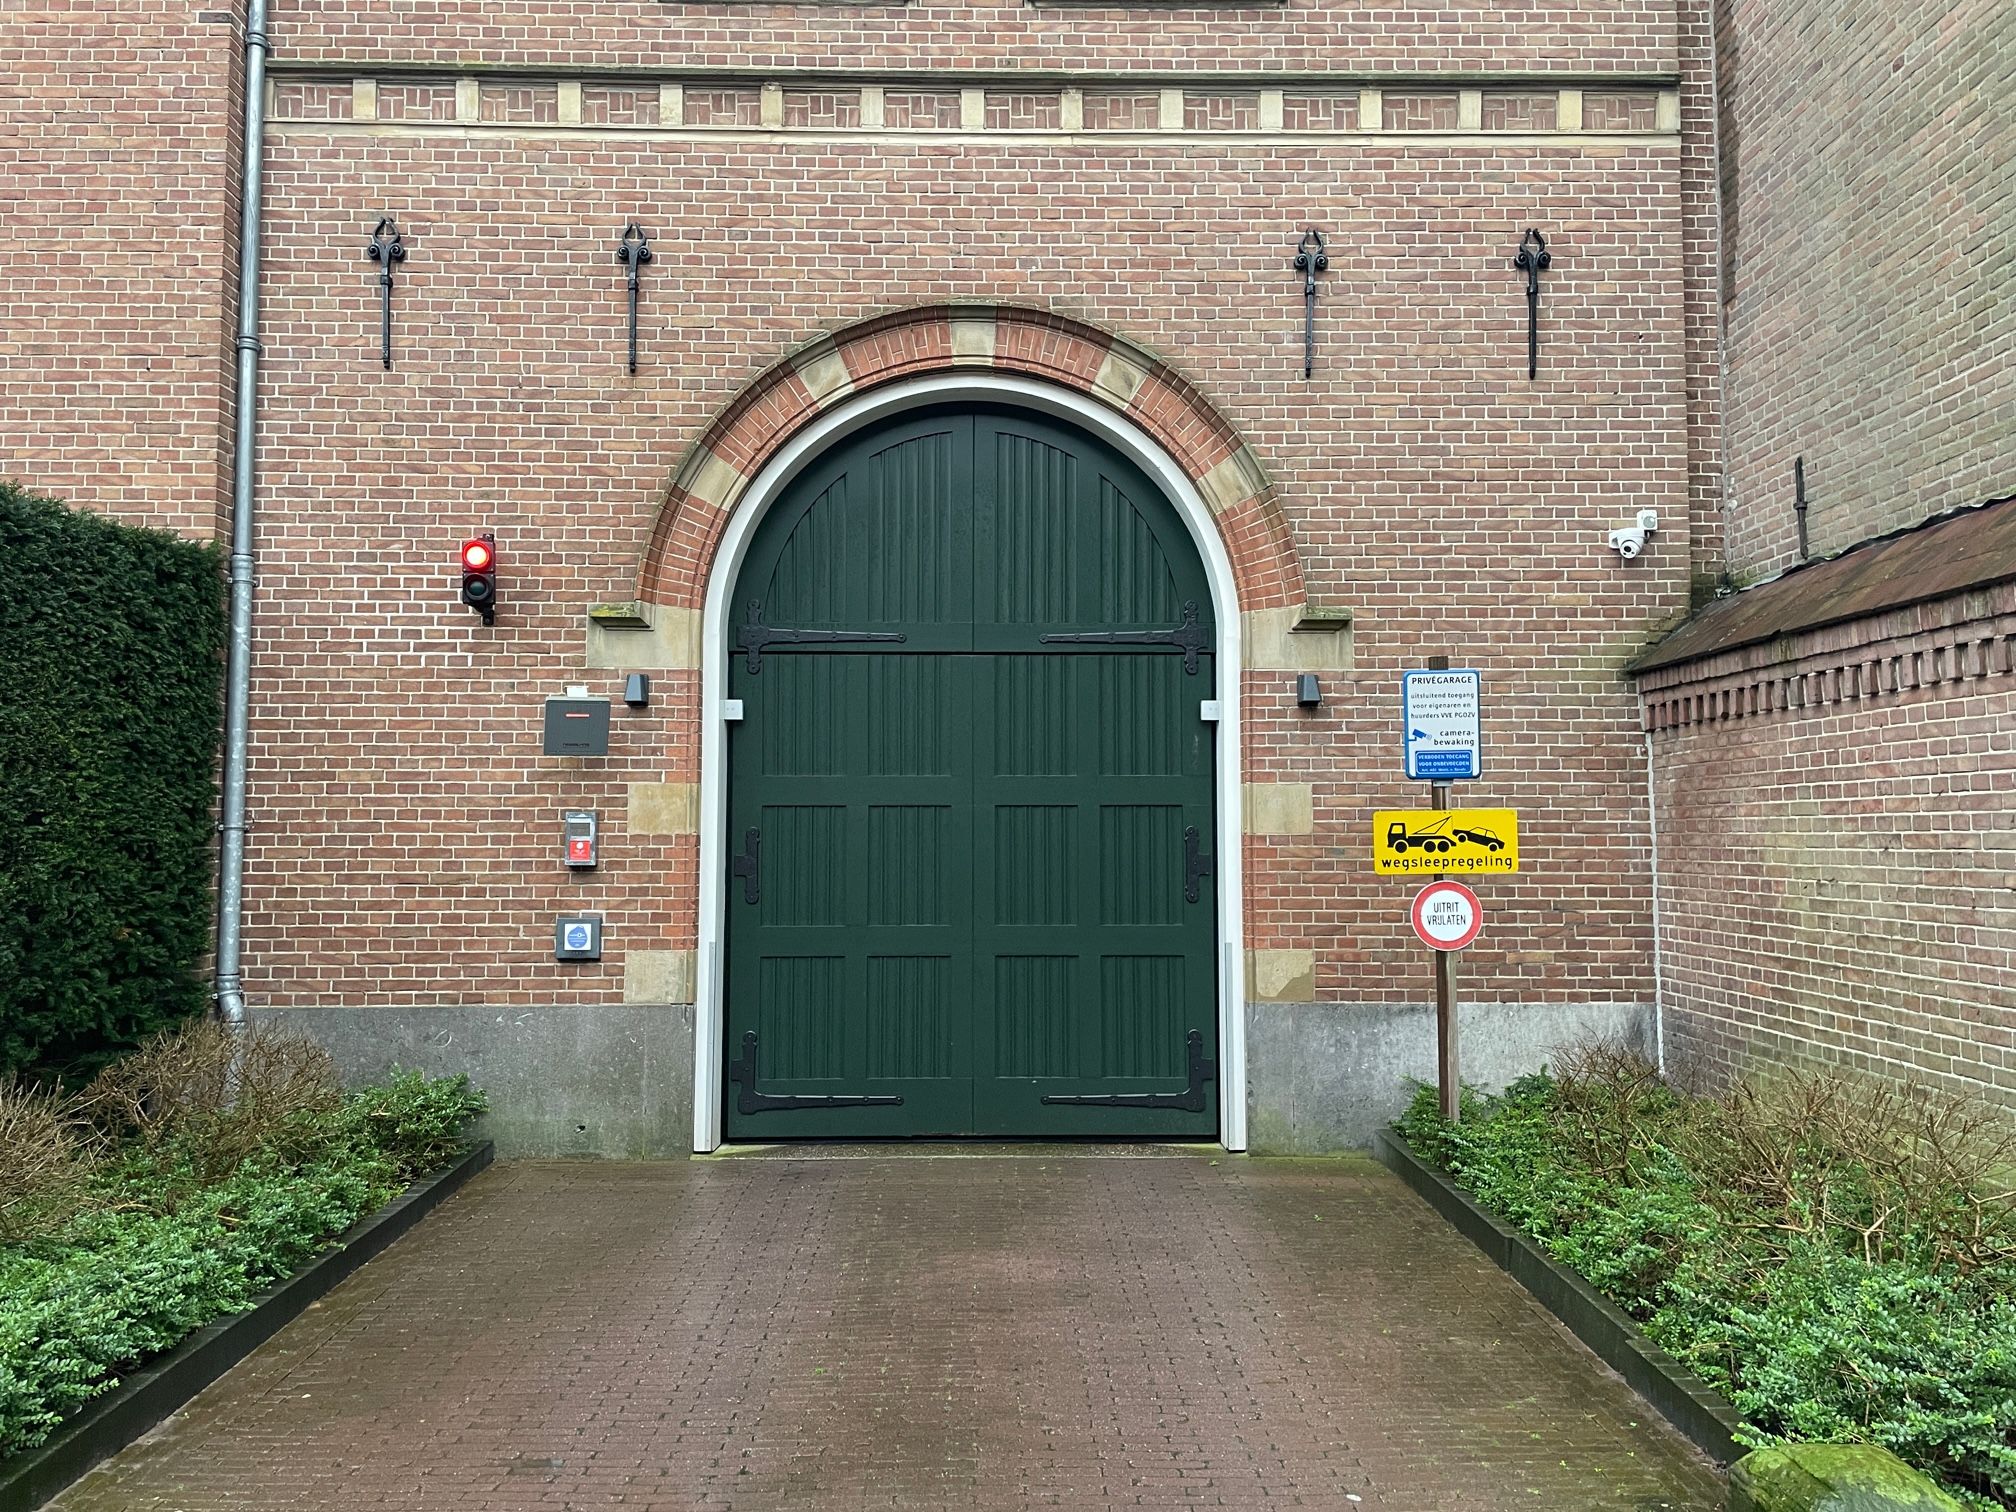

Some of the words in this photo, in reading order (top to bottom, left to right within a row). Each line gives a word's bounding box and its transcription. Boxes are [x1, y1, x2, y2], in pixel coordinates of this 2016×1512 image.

[1411, 676, 1472, 684] PRIVÉGARAGE
[1433, 738, 1475, 746] bewaking
[1381, 855, 1513, 870] wegsleepregeling
[1433, 901, 1459, 913] UITRIT
[1426, 914, 1466, 926] VRIJLATEN
